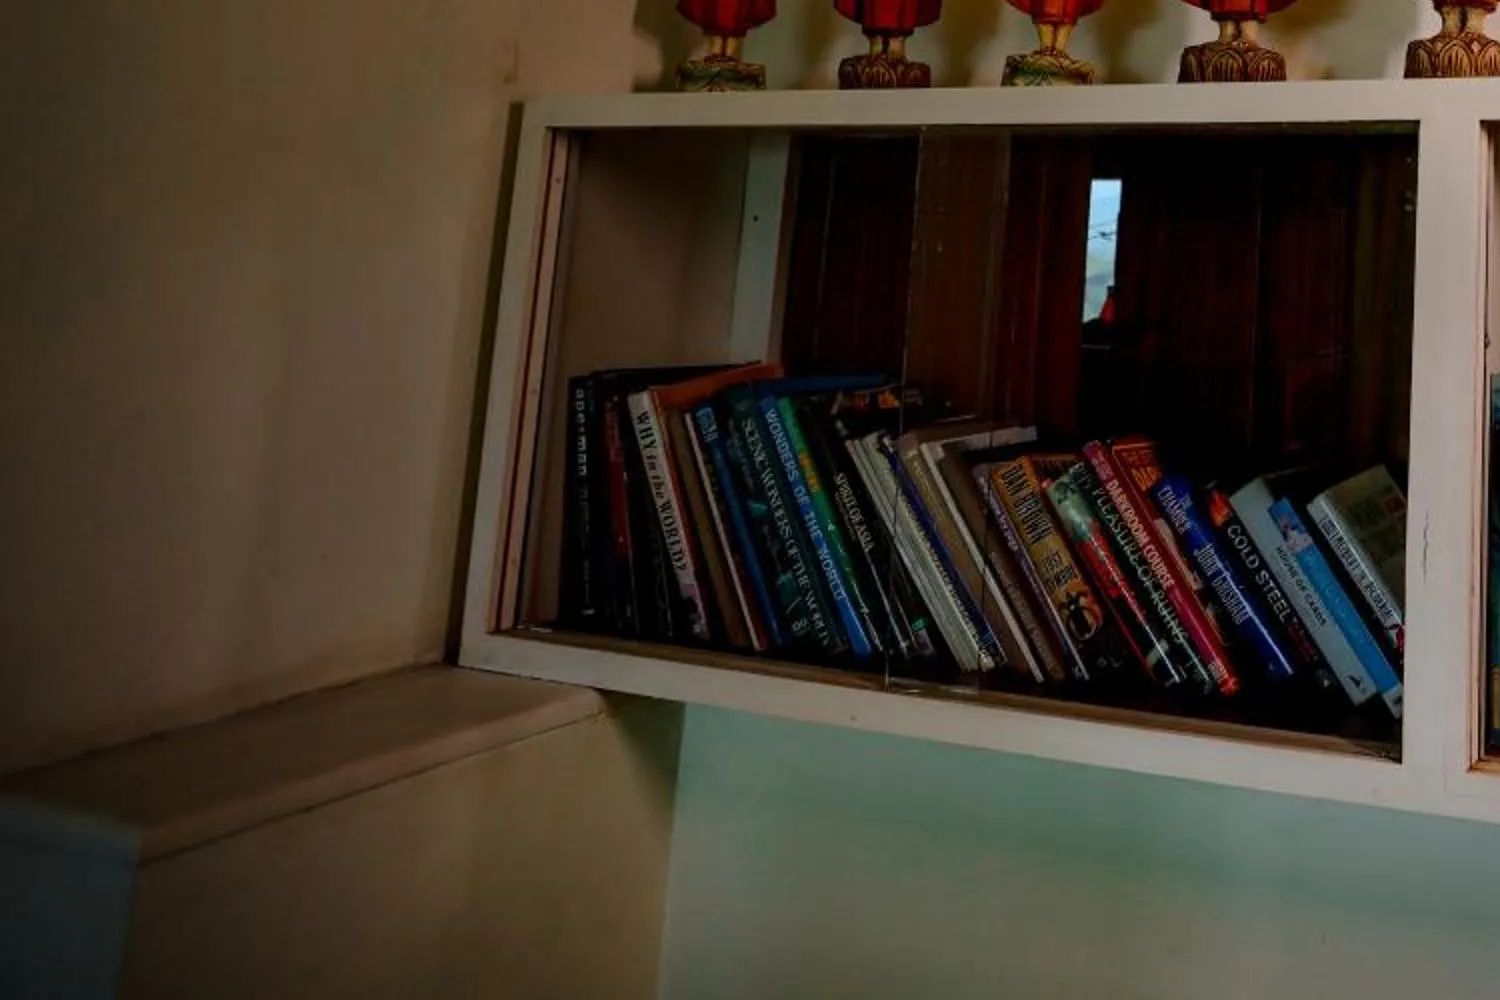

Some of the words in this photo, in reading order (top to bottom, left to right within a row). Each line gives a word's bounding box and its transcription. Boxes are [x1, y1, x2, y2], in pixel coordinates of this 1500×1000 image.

[635, 410, 657, 451] WHY
[650, 473, 666, 500] the
[761, 407, 802, 482] WONDERS
[792, 484, 811, 506] OF
[802, 509, 824, 541] THE
[815, 544, 847, 601] WORLD
[656, 499, 688, 572] WORLD?
[1090, 486, 1144, 567] PLEASURE
[1133, 562, 1161, 595] OF
[1148, 589, 1189, 643] RUINS
[1102, 477, 1152, 548] DARKROOM
[1139, 541, 1176, 590] COURSE
[1191, 541, 1225, 578] JOHN
[1223, 521, 1262, 571] COLD
[1252, 568, 1294, 624] STEEL
